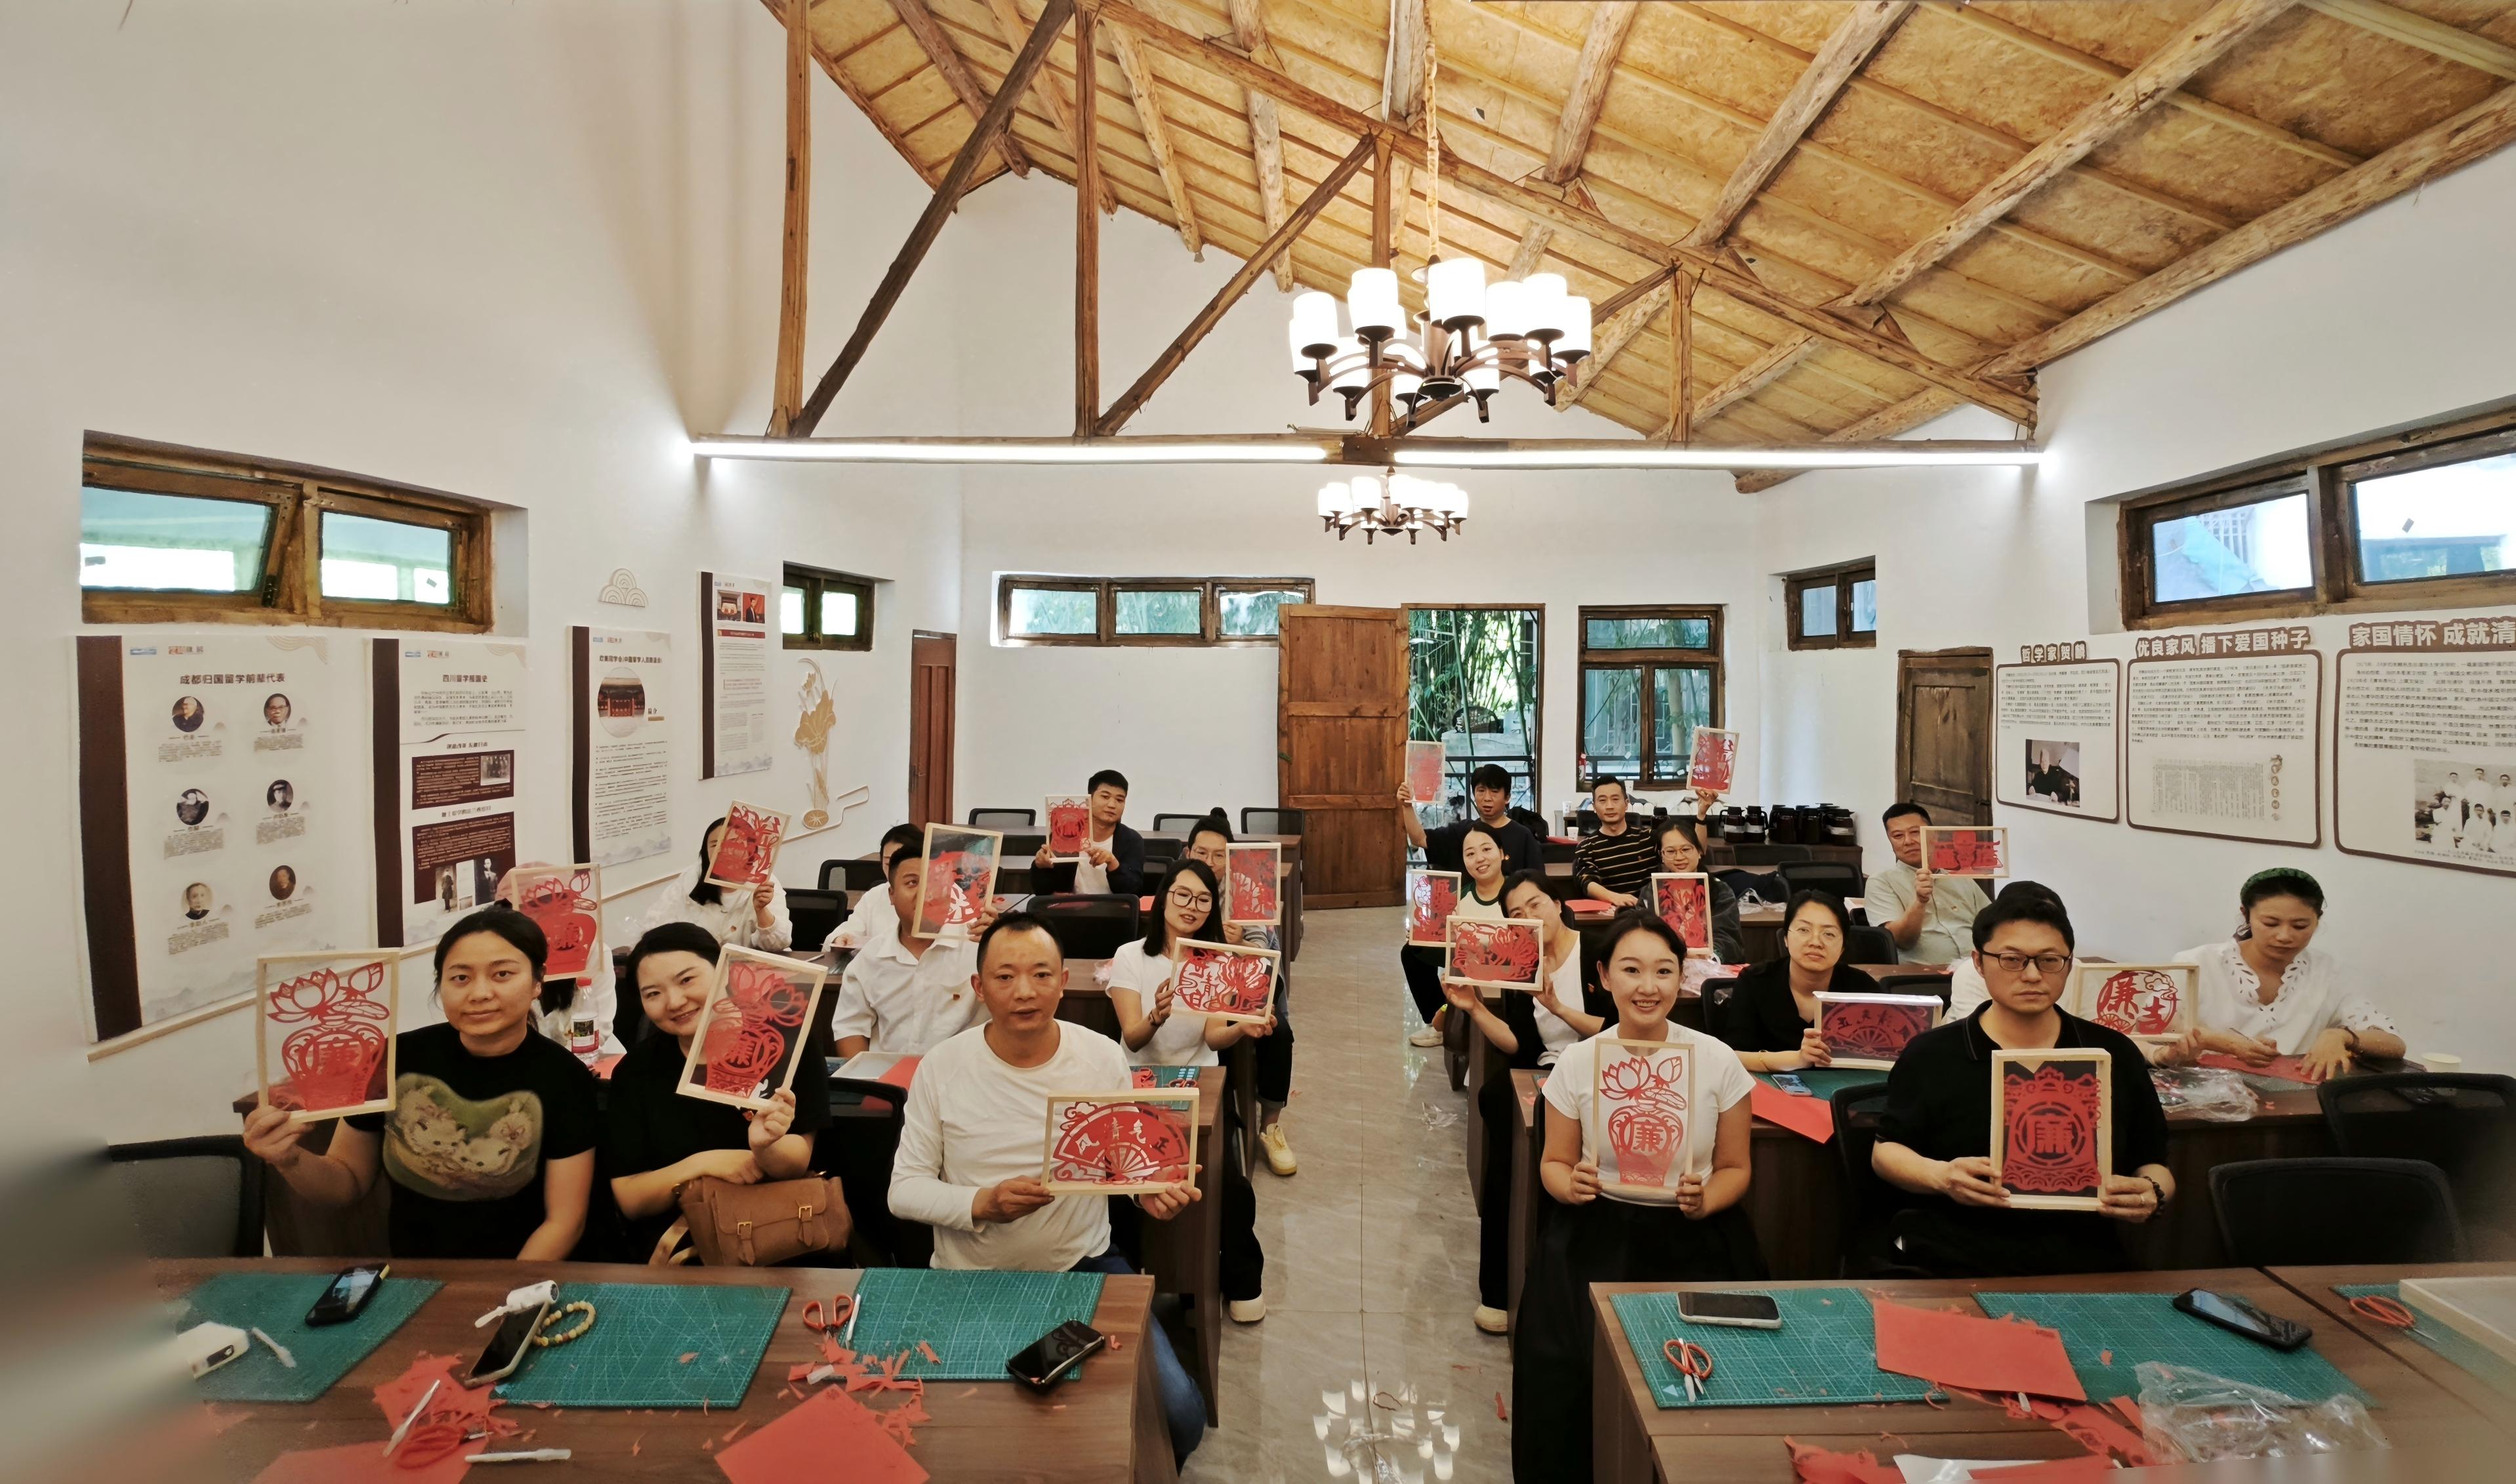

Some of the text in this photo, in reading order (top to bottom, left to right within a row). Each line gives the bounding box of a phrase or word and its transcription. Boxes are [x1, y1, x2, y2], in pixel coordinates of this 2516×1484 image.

[2137, 629, 2309, 657] 优良家风 播下爱国种子
[2351, 620, 2516, 647] 家国情怀 成就清
